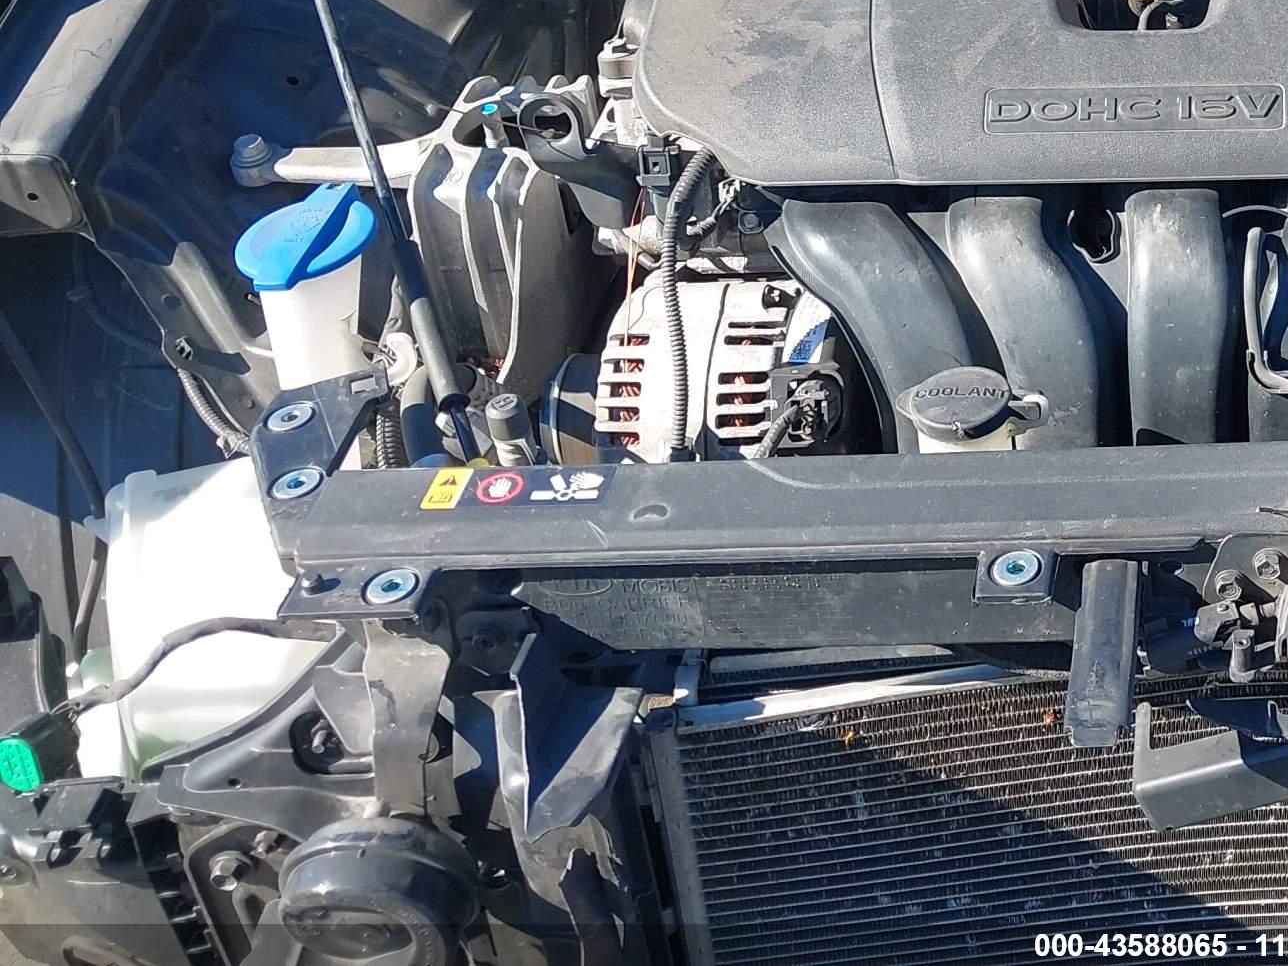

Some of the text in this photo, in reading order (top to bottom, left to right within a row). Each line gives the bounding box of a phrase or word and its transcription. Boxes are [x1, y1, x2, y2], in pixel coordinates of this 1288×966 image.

[989, 93, 1280, 123] DOHC 16V
[915, 386, 1010, 399] COOLANT
